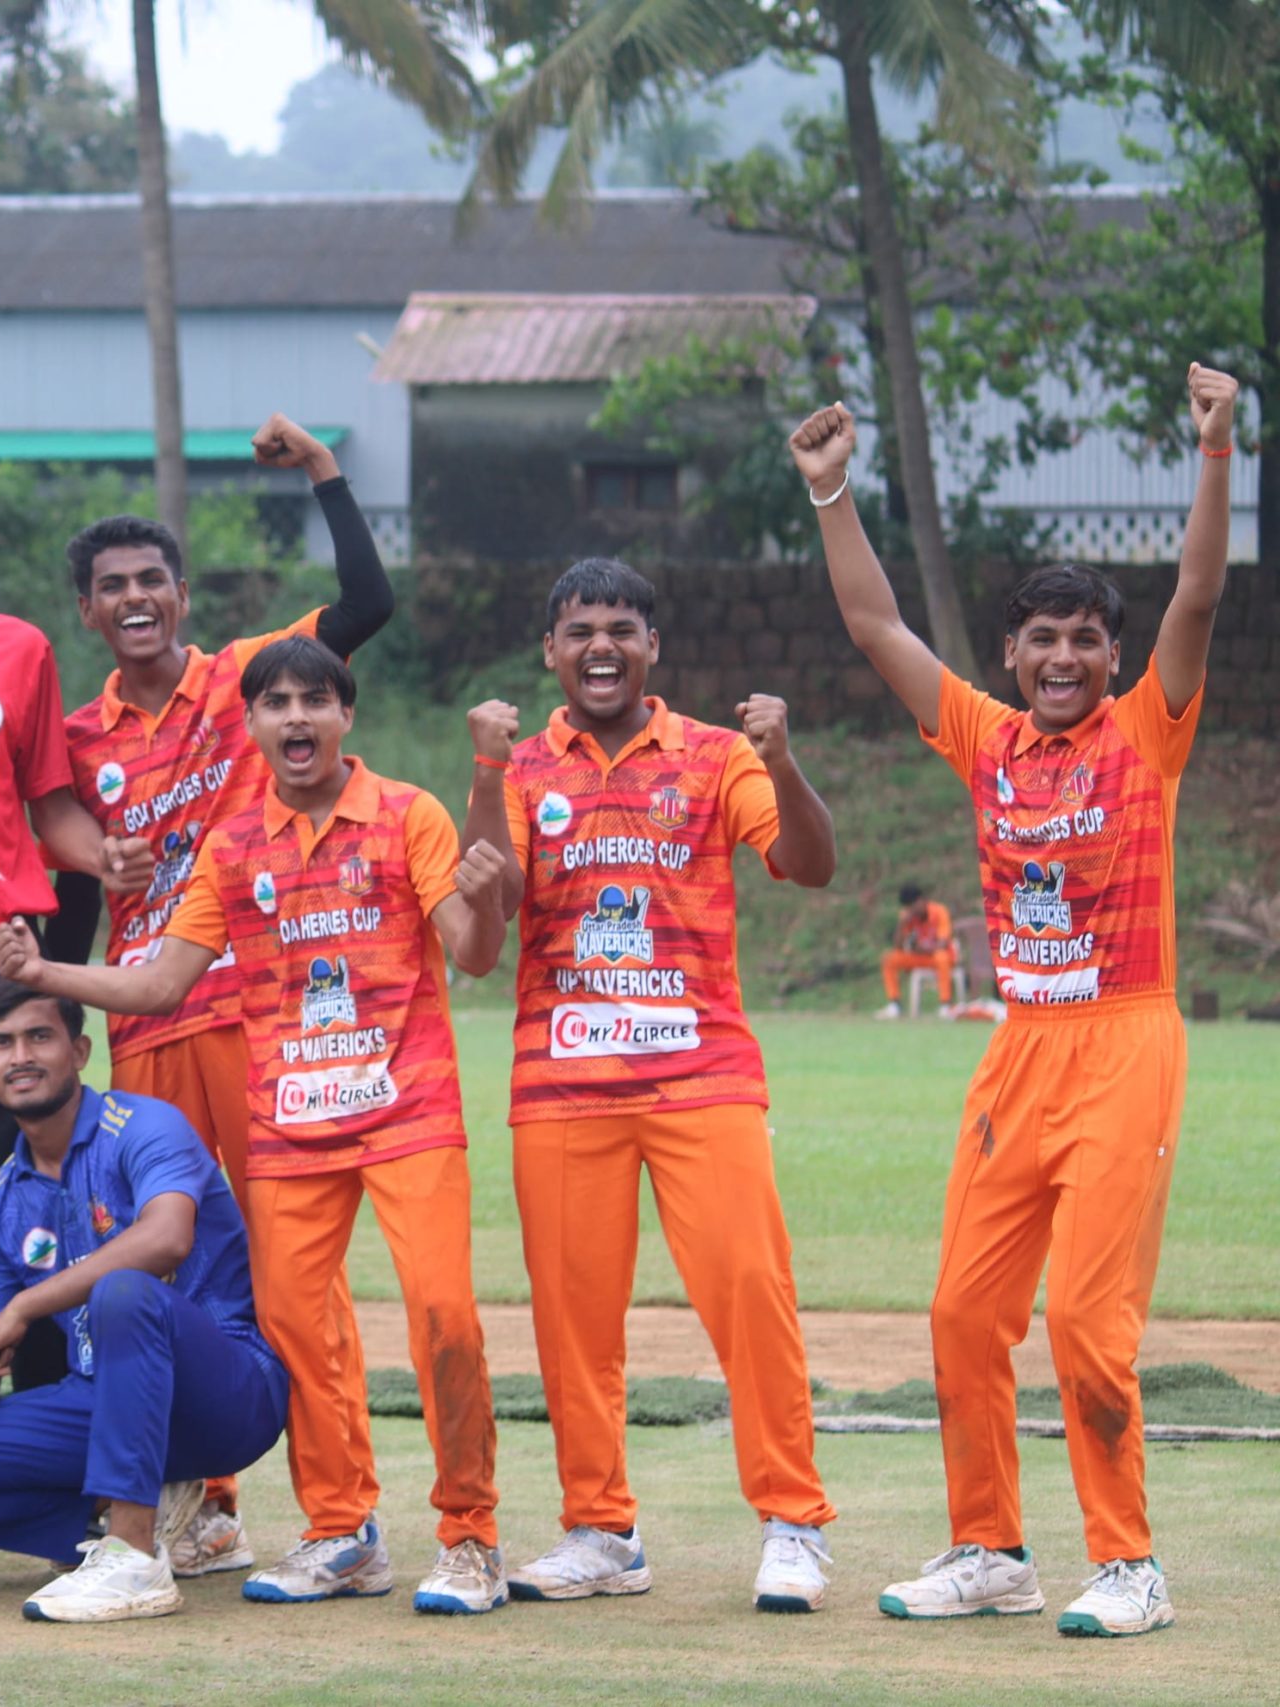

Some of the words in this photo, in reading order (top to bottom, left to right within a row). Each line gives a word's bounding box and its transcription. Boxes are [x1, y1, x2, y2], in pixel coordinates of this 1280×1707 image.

[1073, 806, 1105, 837] CUP
[563, 839, 595, 871] GOA
[595, 836, 657, 865] HEROES
[658, 841, 691, 871] CUP
[280, 917, 301, 944] OA
[301, 908, 350, 940] HERES
[352, 907, 382, 932] CUP
[582, 920, 605, 932] Uttar
[606, 920, 642, 931] Pradesh
[575, 931, 653, 962] MAVERICKS
